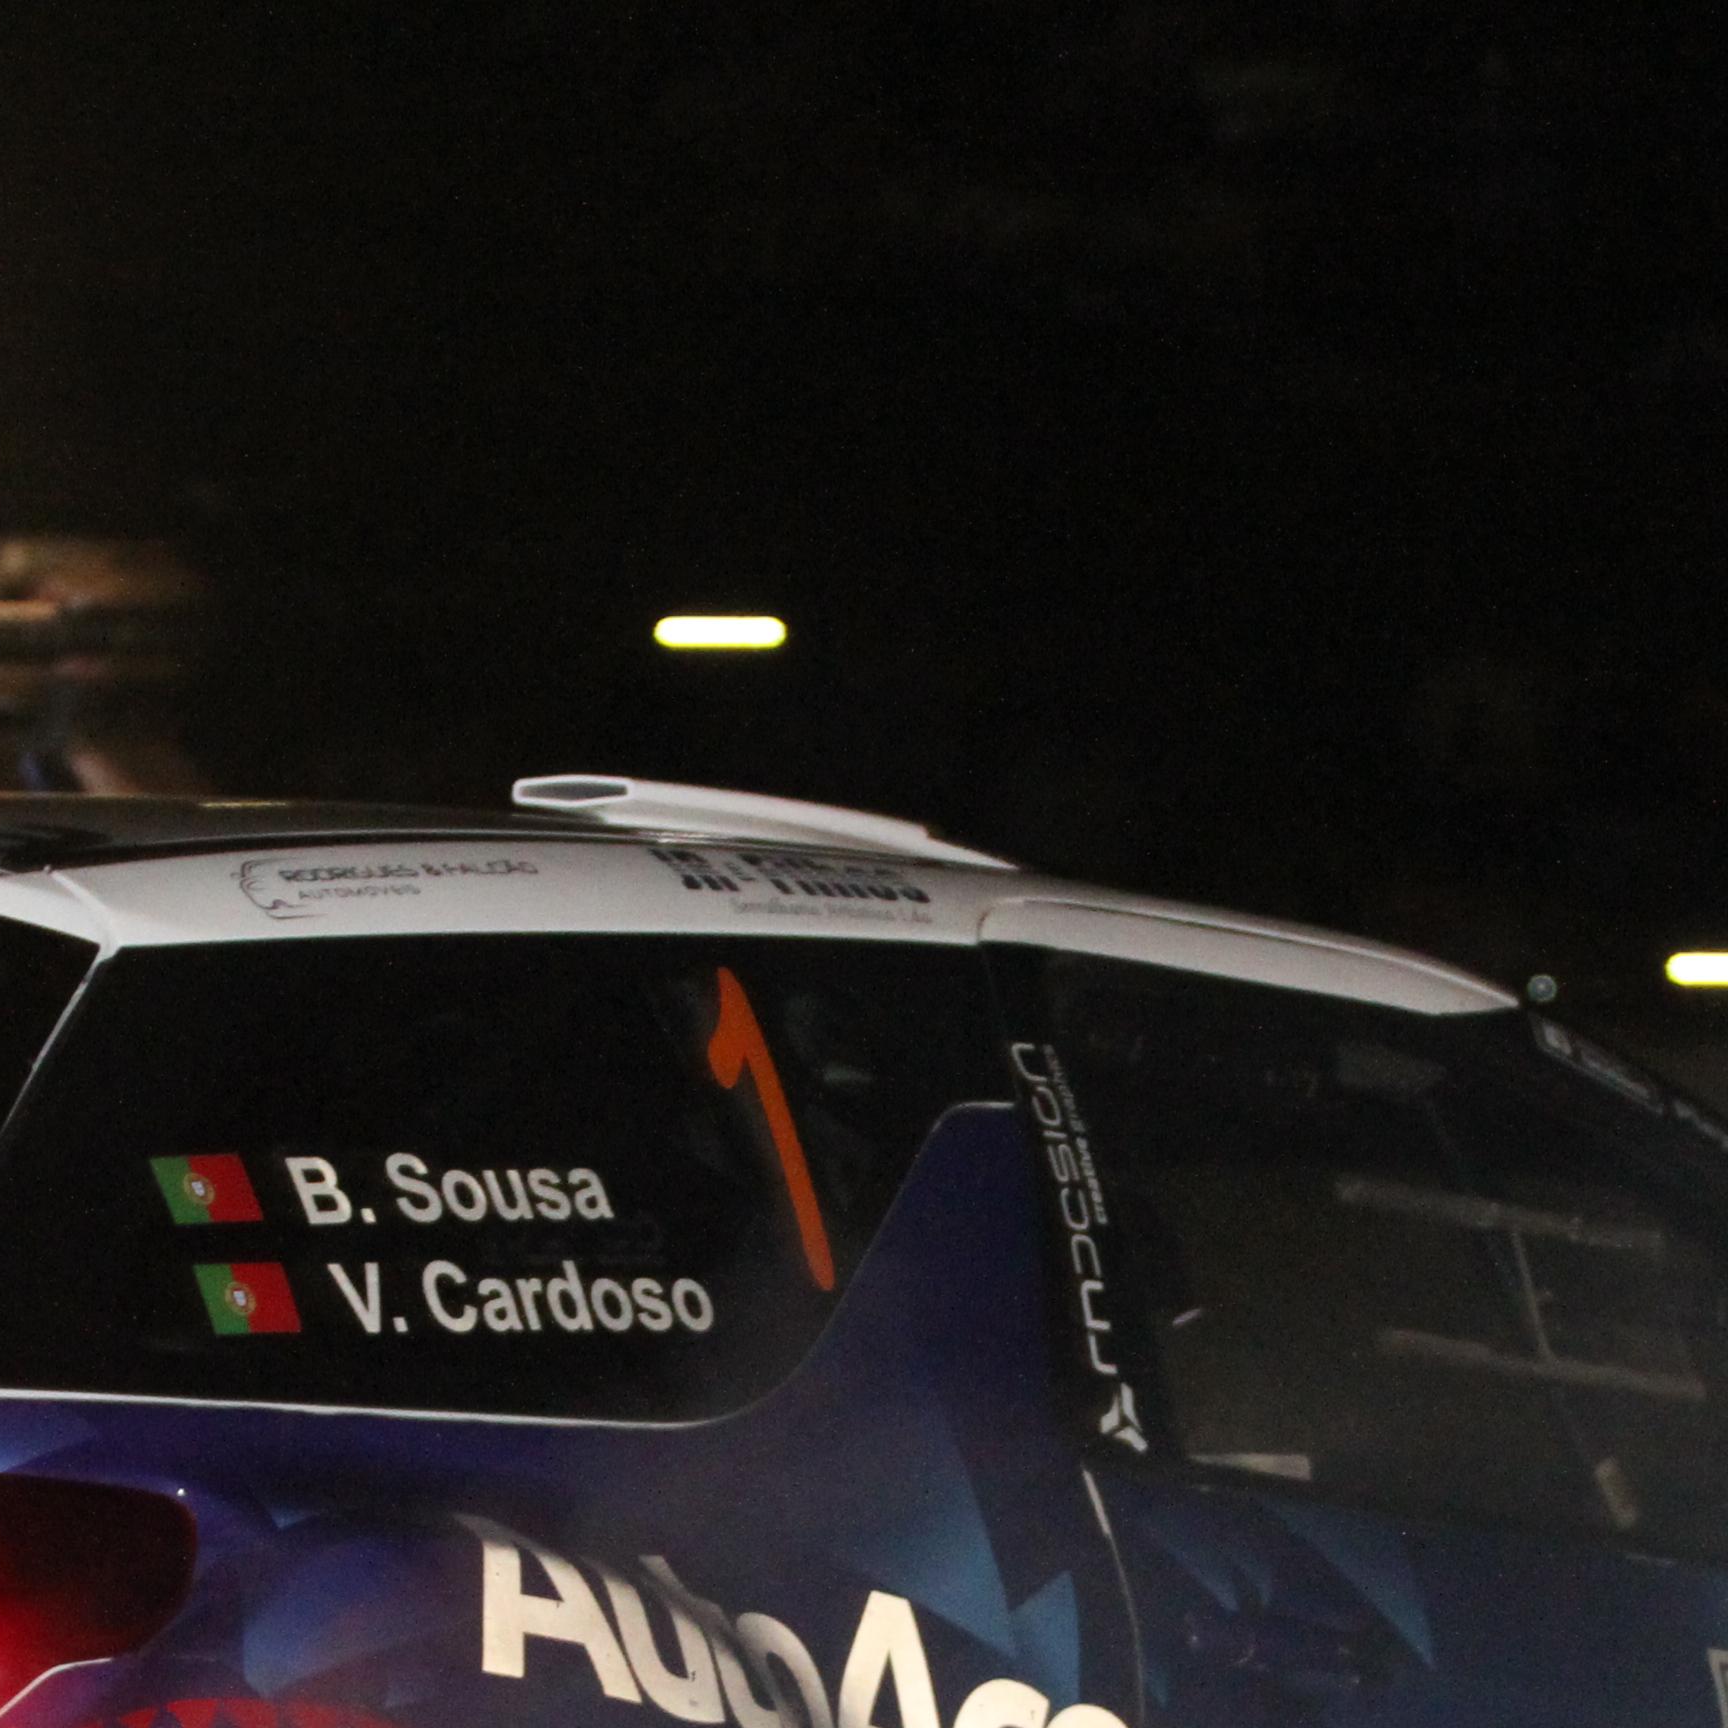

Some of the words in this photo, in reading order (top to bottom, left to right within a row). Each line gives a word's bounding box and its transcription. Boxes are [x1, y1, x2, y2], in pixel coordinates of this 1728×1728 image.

[708, 967, 835, 1291] 1
[284, 1155, 377, 1226] B.
[394, 1152, 615, 1225] Sousa
[327, 1261, 410, 1335] V.
[422, 1258, 715, 1334] Cardoso
